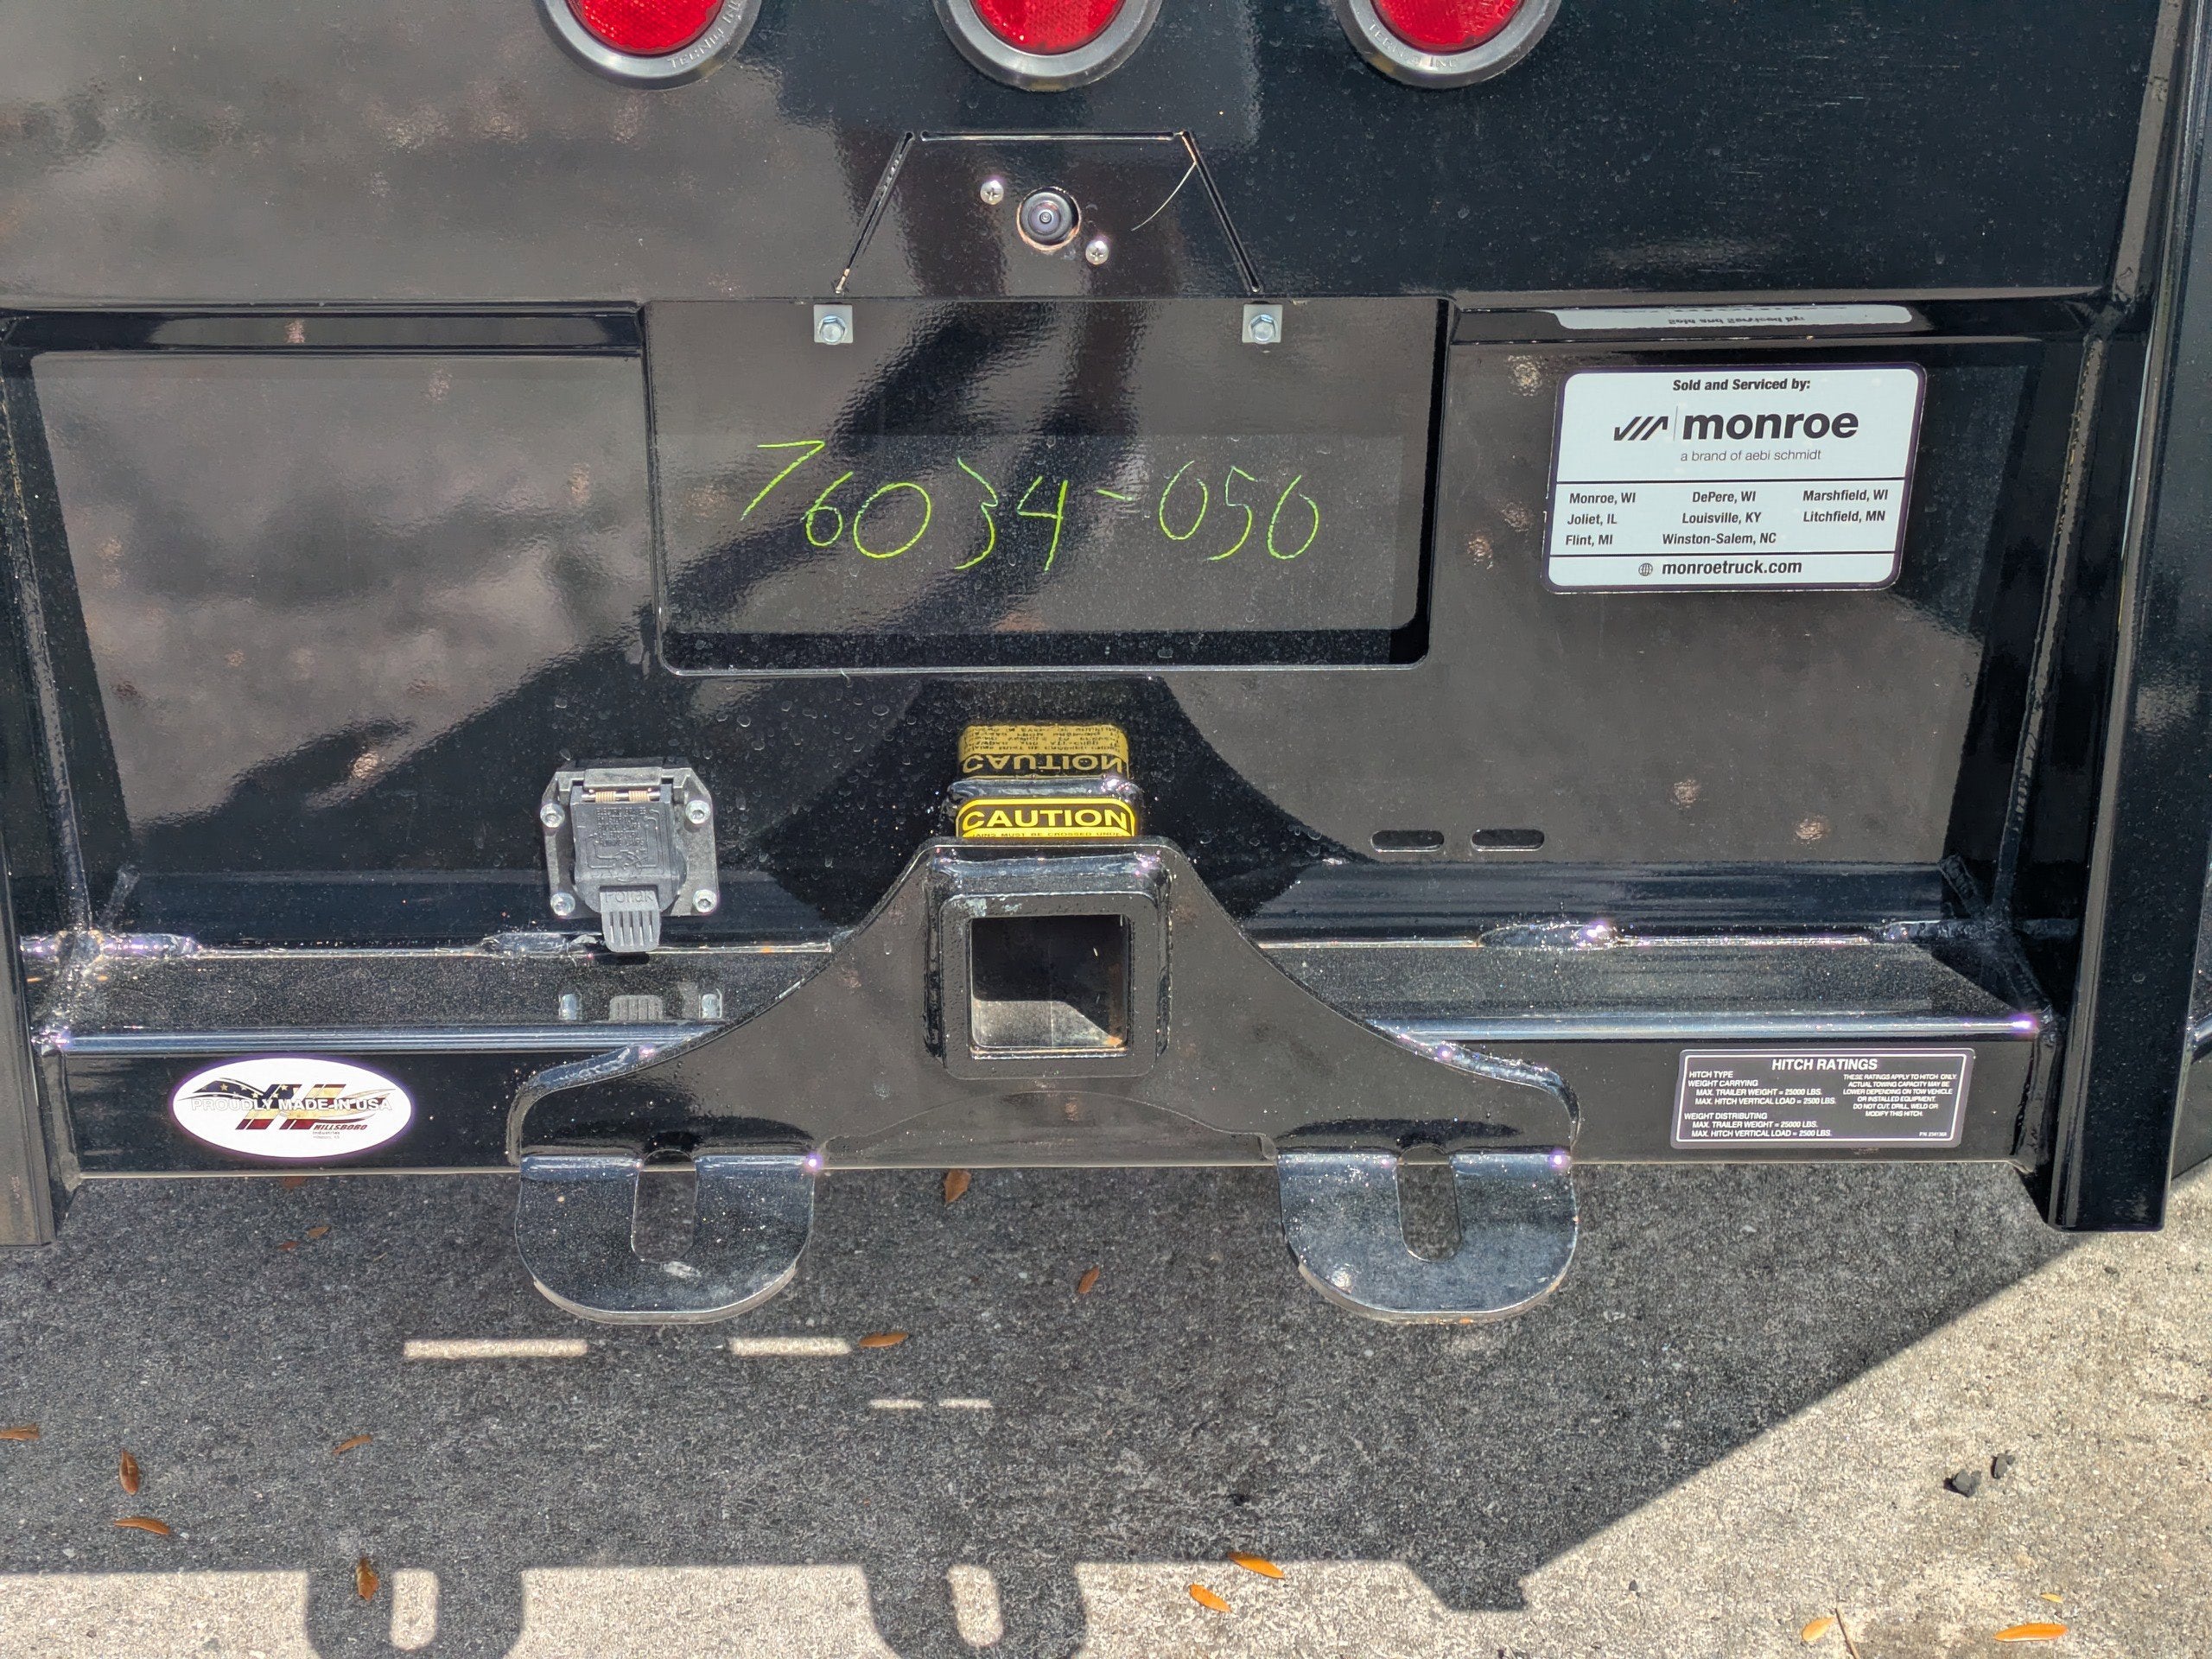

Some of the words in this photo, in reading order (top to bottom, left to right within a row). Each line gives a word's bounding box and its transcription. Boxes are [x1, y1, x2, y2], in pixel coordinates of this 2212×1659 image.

[1673, 379, 1700, 391] Sold
[1704, 379, 1729, 391] and
[1732, 378, 1788, 390] Serviced
[1791, 378, 1810, 392] by:
[1682, 411, 1859, 440] monroe
[1681, 453, 1688, 461] a
[1691, 450, 1726, 461] brand
[1730, 450, 1742, 461] of
[1745, 450, 1770, 461] aebi
[1774, 449, 1821, 461] schmidt
[1569, 493, 1618, 505] Monroe,
[1621, 493, 1636, 503] WI
[1692, 492, 1738, 505] DePere,
[1741, 492, 1756, 502] WI
[1802, 489, 1870, 503] Marshfield,
[1873, 489, 1888, 500] WI
[1567, 514, 1604, 527] Joliet,
[1607, 514, 1618, 524] IL
[1681, 512, 1740, 525] Louisville,
[1745, 512, 1762, 523] KY
[1803, 511, 1862, 524] Litchfield,
[1866, 511, 1885, 521] MN
[1566, 535, 1595, 548] Flint,
[1598, 535, 1613, 545] MI
[1662, 533, 1756, 546] Winston-Salem,
[1759, 532, 1777, 543] NC
[1662, 561, 1802, 575] monroetruck.com
[962, 809, 1126, 831] CAUTION
[1772, 1059, 1813, 1071] HITCH
[1816, 1058, 1878, 1071] RATINGS
[191, 1099, 273, 1111] PROUDLY
[278, 1099, 327, 1110] MADE
[334, 1099, 351, 1110] IN
[355, 1099, 393, 1111] USA
